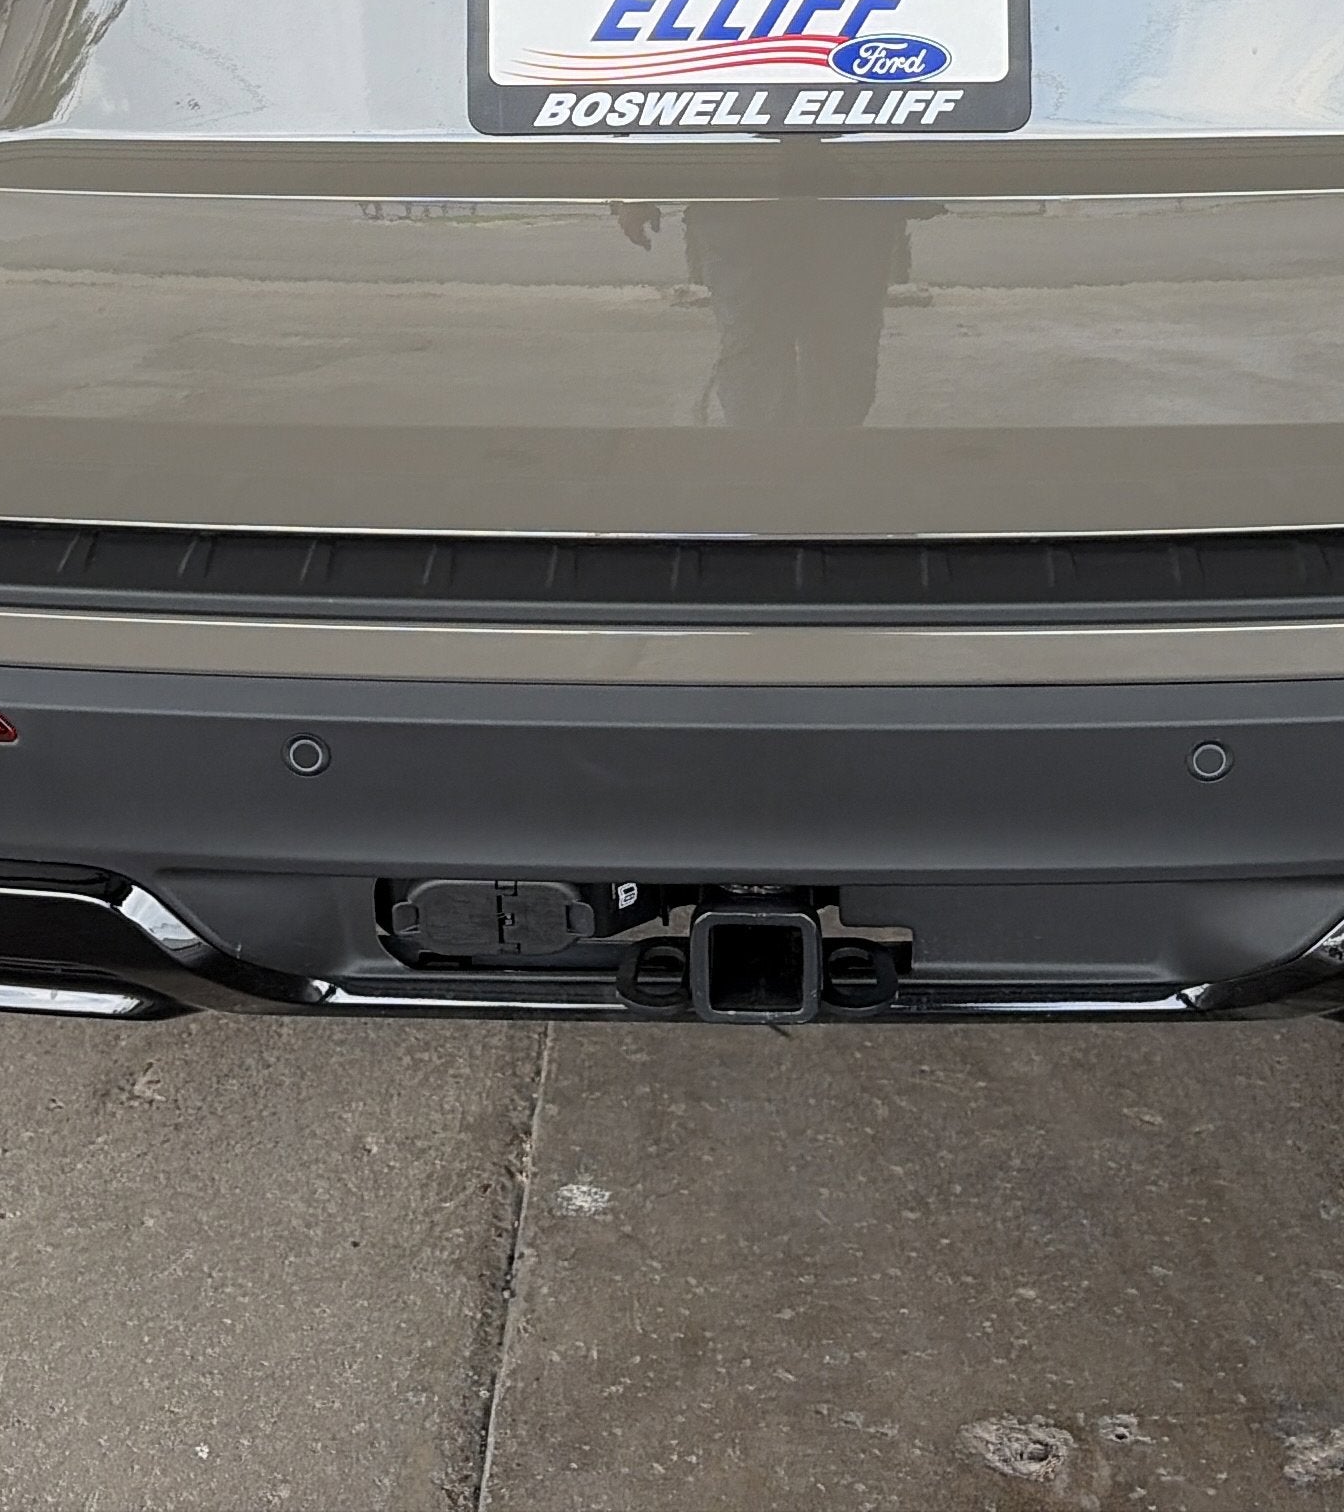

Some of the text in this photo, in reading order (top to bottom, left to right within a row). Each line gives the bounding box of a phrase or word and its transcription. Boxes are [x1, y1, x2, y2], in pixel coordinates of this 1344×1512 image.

[852, 42, 926, 76] Ford
[533, 90, 964, 127] BOSWELL ELLIFF
